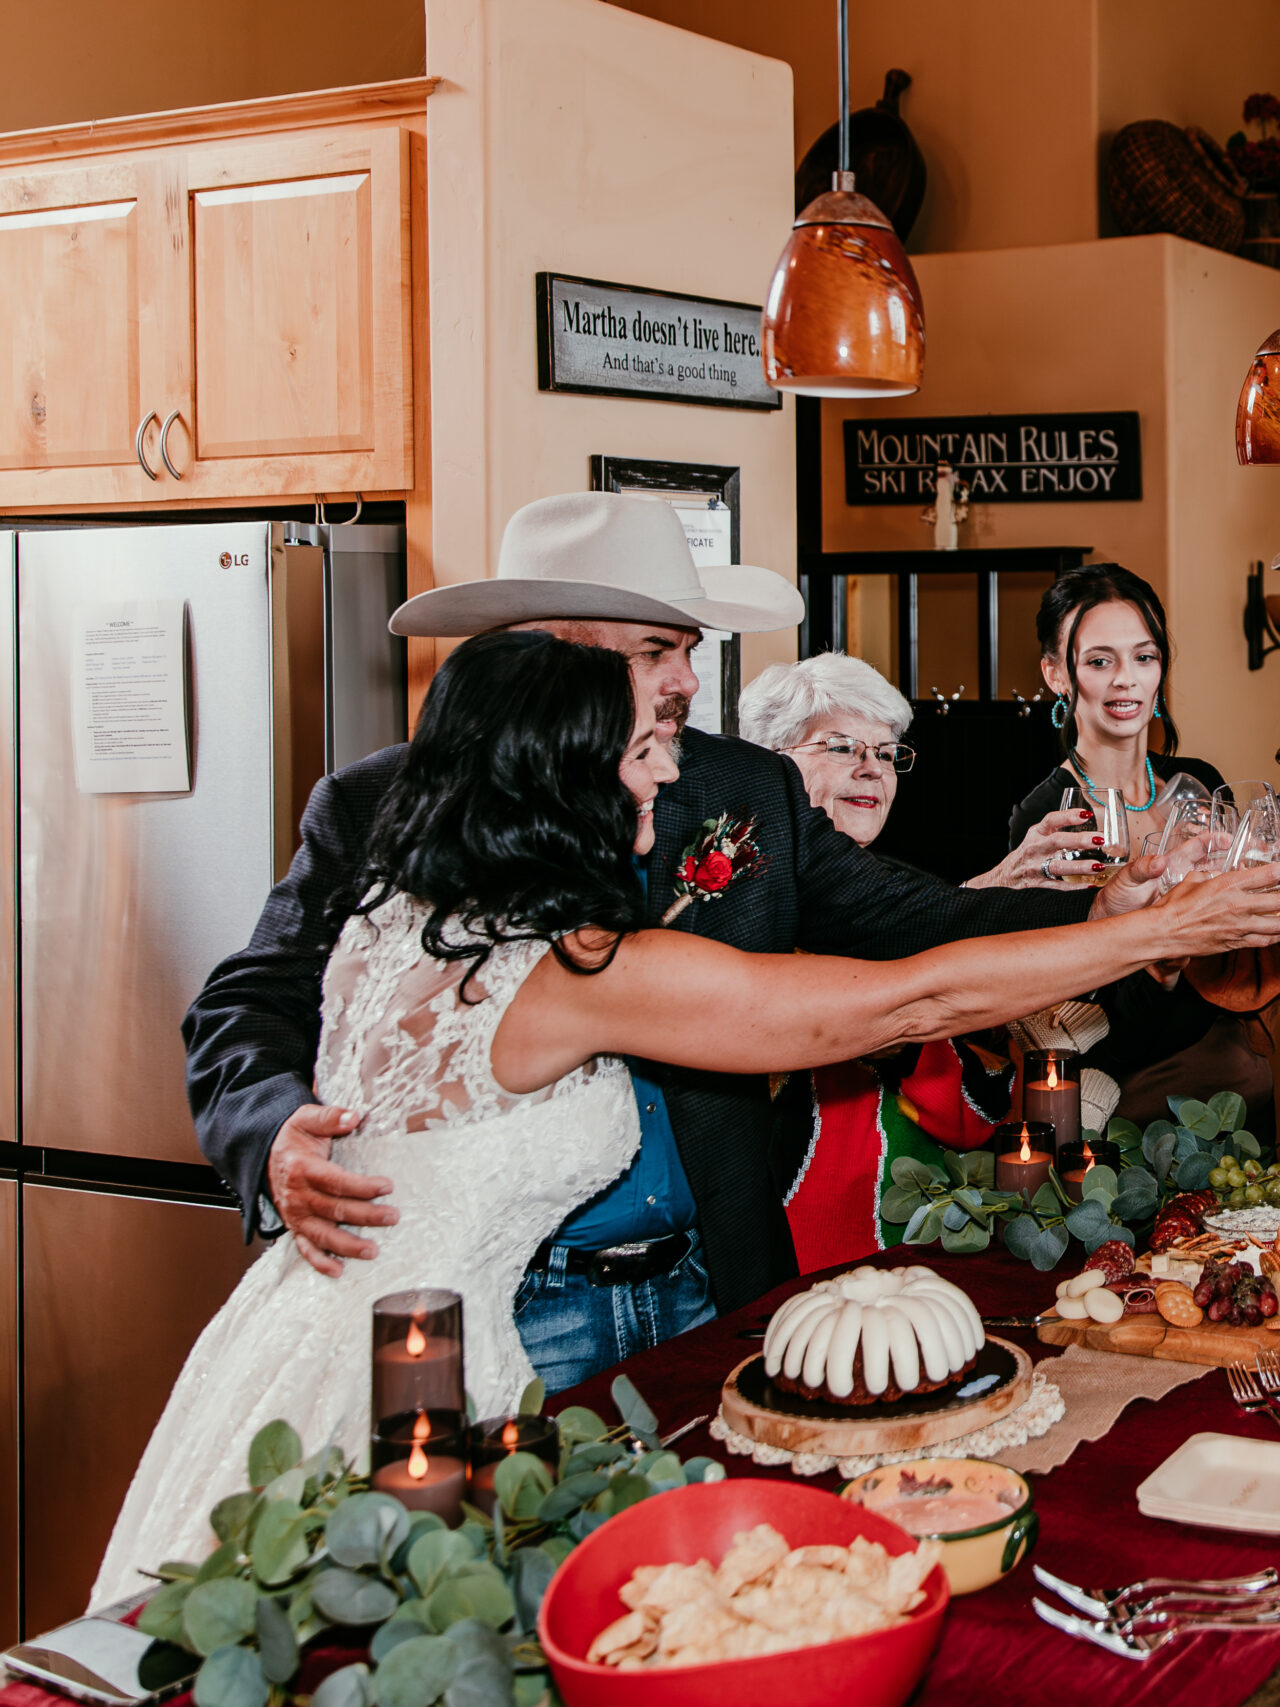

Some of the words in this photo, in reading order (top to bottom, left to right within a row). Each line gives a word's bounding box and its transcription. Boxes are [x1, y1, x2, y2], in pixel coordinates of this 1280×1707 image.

[562, 300, 628, 340] Martha
[632, 310, 690, 347] doesn't
[693, 318, 719, 351] live
[602, 352, 629, 371] And
[632, 357, 664, 375] that's
[667, 363, 674, 376] a
[677, 364, 706, 382] good
[708, 364, 737, 386] thing
[864, 470, 906, 494] SKI
[918, 468, 1009, 493] RAX
[1021, 467, 1116, 493] ENJOY
[234, 554, 249, 566] LG
